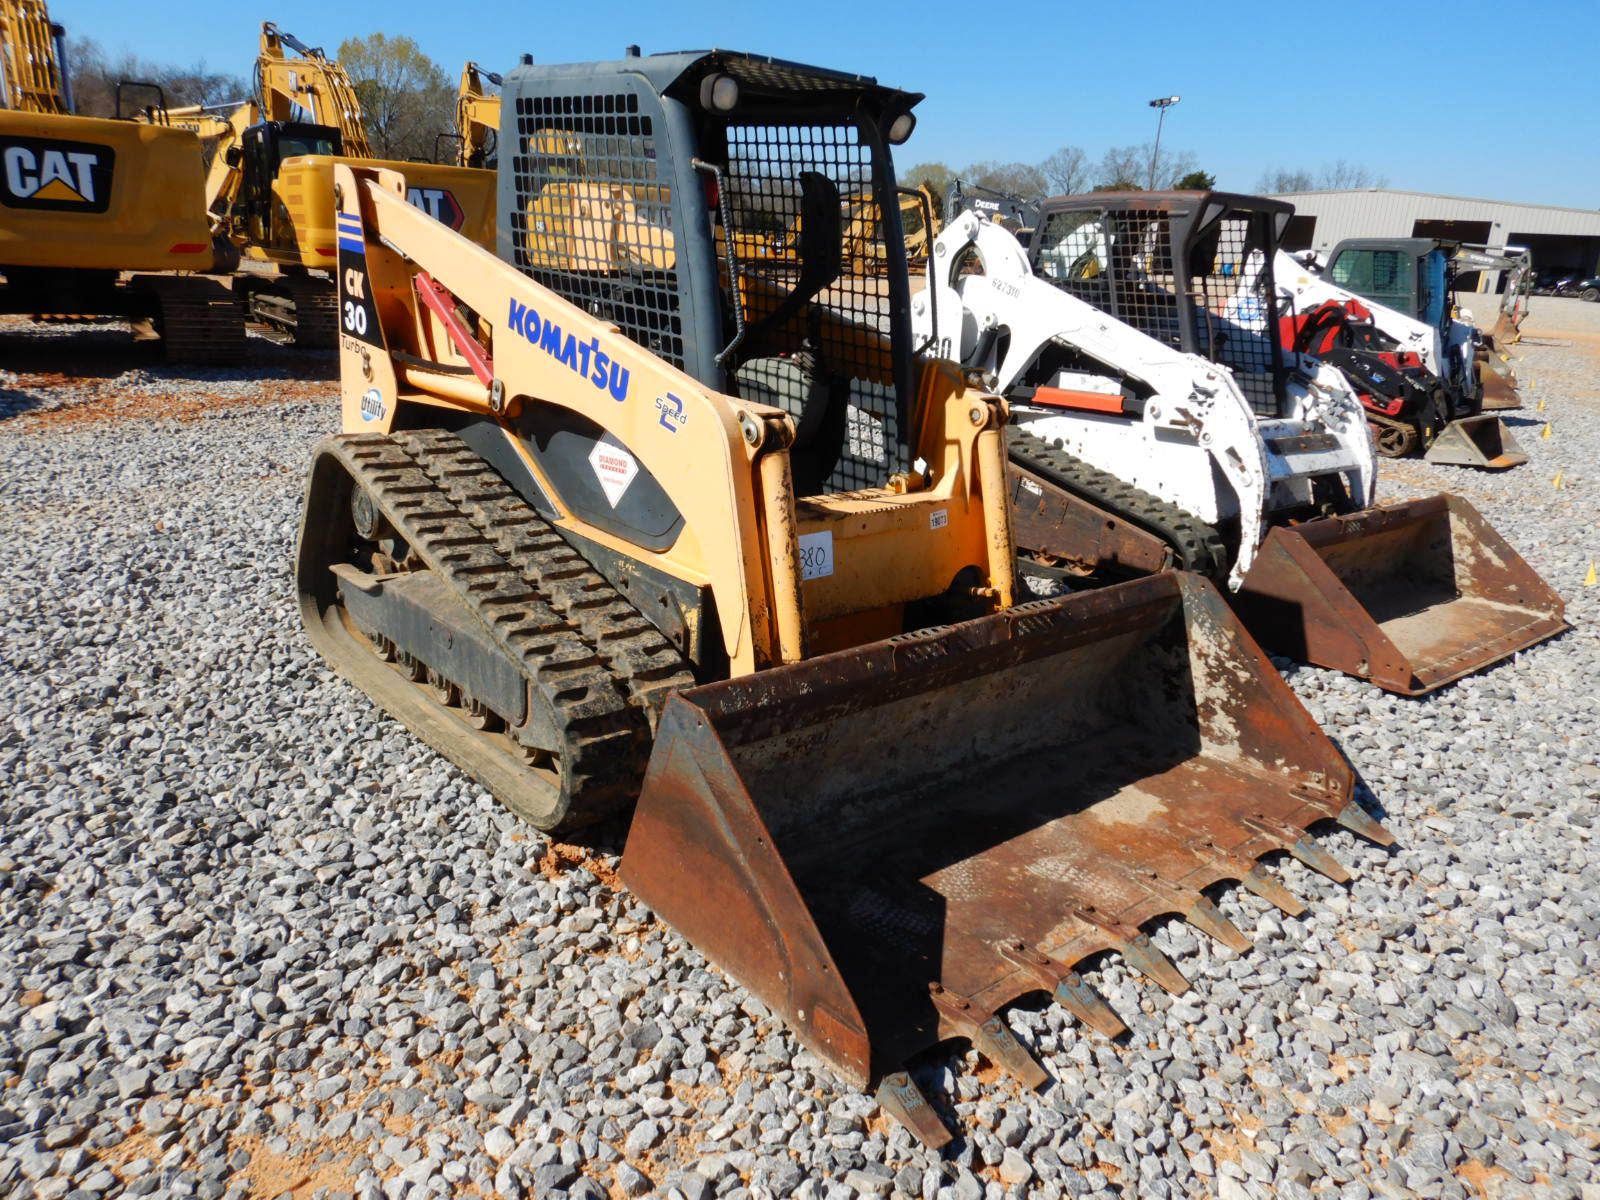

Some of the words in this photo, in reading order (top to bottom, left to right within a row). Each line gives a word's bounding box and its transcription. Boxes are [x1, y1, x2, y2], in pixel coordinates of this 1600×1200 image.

[4, 146, 98, 202] CAT
[407, 188, 444, 221] AT
[975, 199, 1000, 210] DEERE
[345, 268, 365, 299] CK
[344, 301, 367, 335] 30
[340, 335, 367, 355] Turbo
[508, 297, 630, 402] KOMATSU
[361, 395, 387, 421] Utility
[655, 397, 687, 424] Speed
[599, 455, 628, 468] DIAMOND
